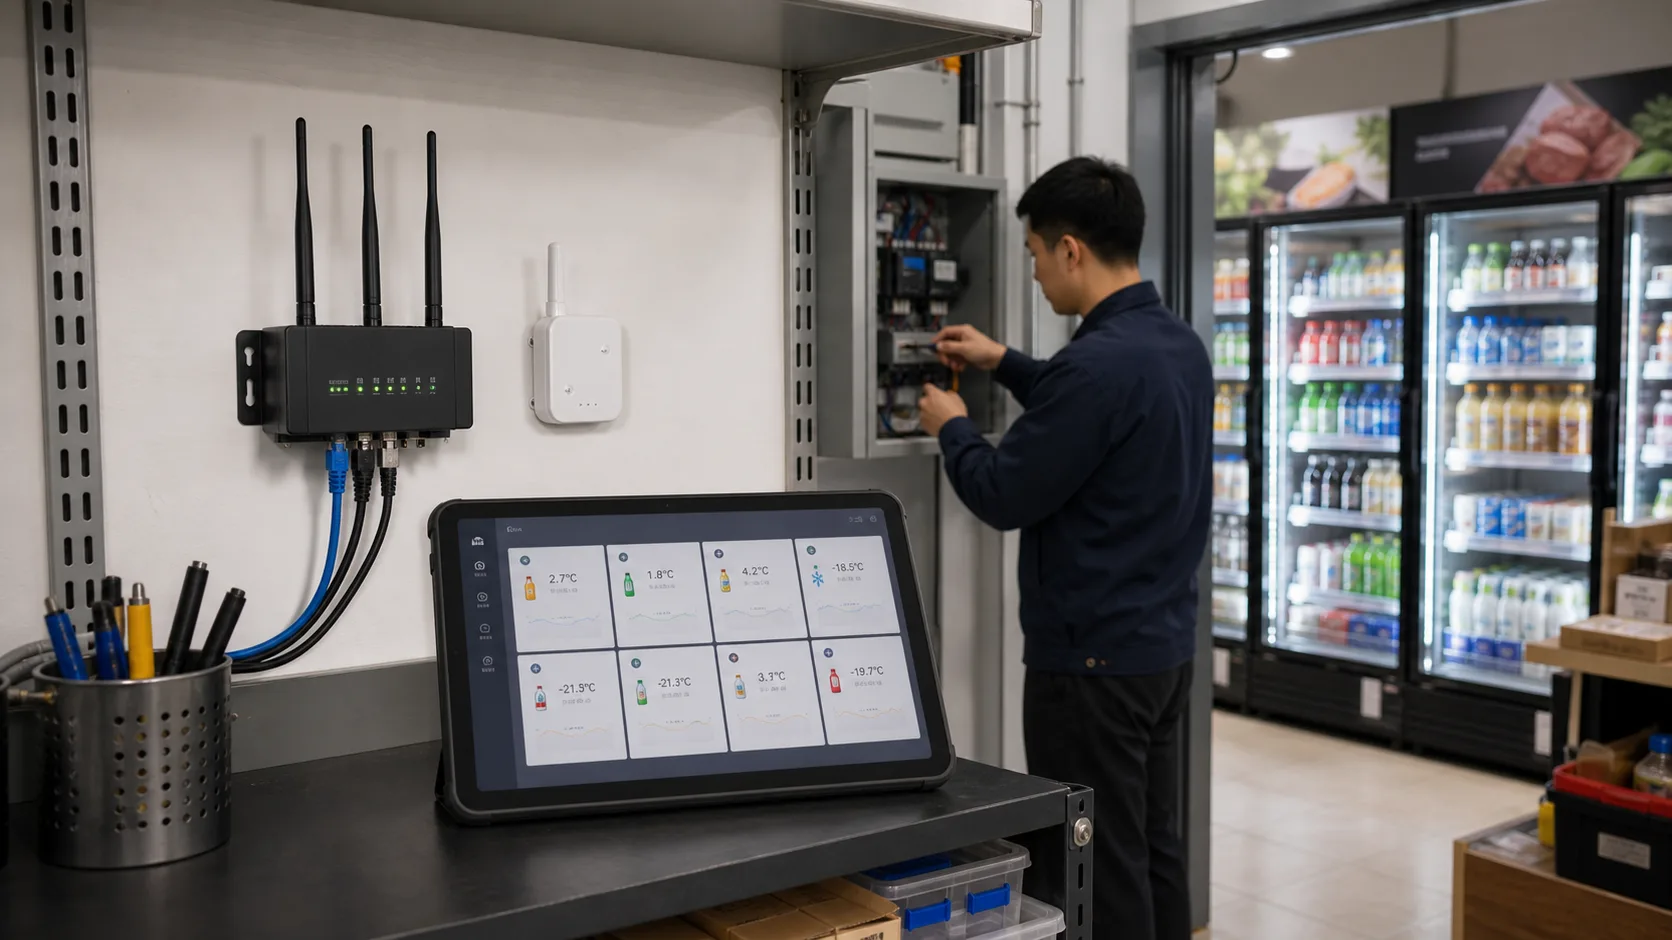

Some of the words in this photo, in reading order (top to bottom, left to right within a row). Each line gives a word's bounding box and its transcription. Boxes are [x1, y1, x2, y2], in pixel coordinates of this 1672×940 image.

[741, 565, 769, 576] 4.2°C
[831, 562, 864, 573] -18.5°C
[548, 572, 578, 583] 2.7°C
[647, 569, 674, 580] 1.8°C
[850, 665, 884, 677] -19.7°C
[657, 676, 692, 688] -21.3°C
